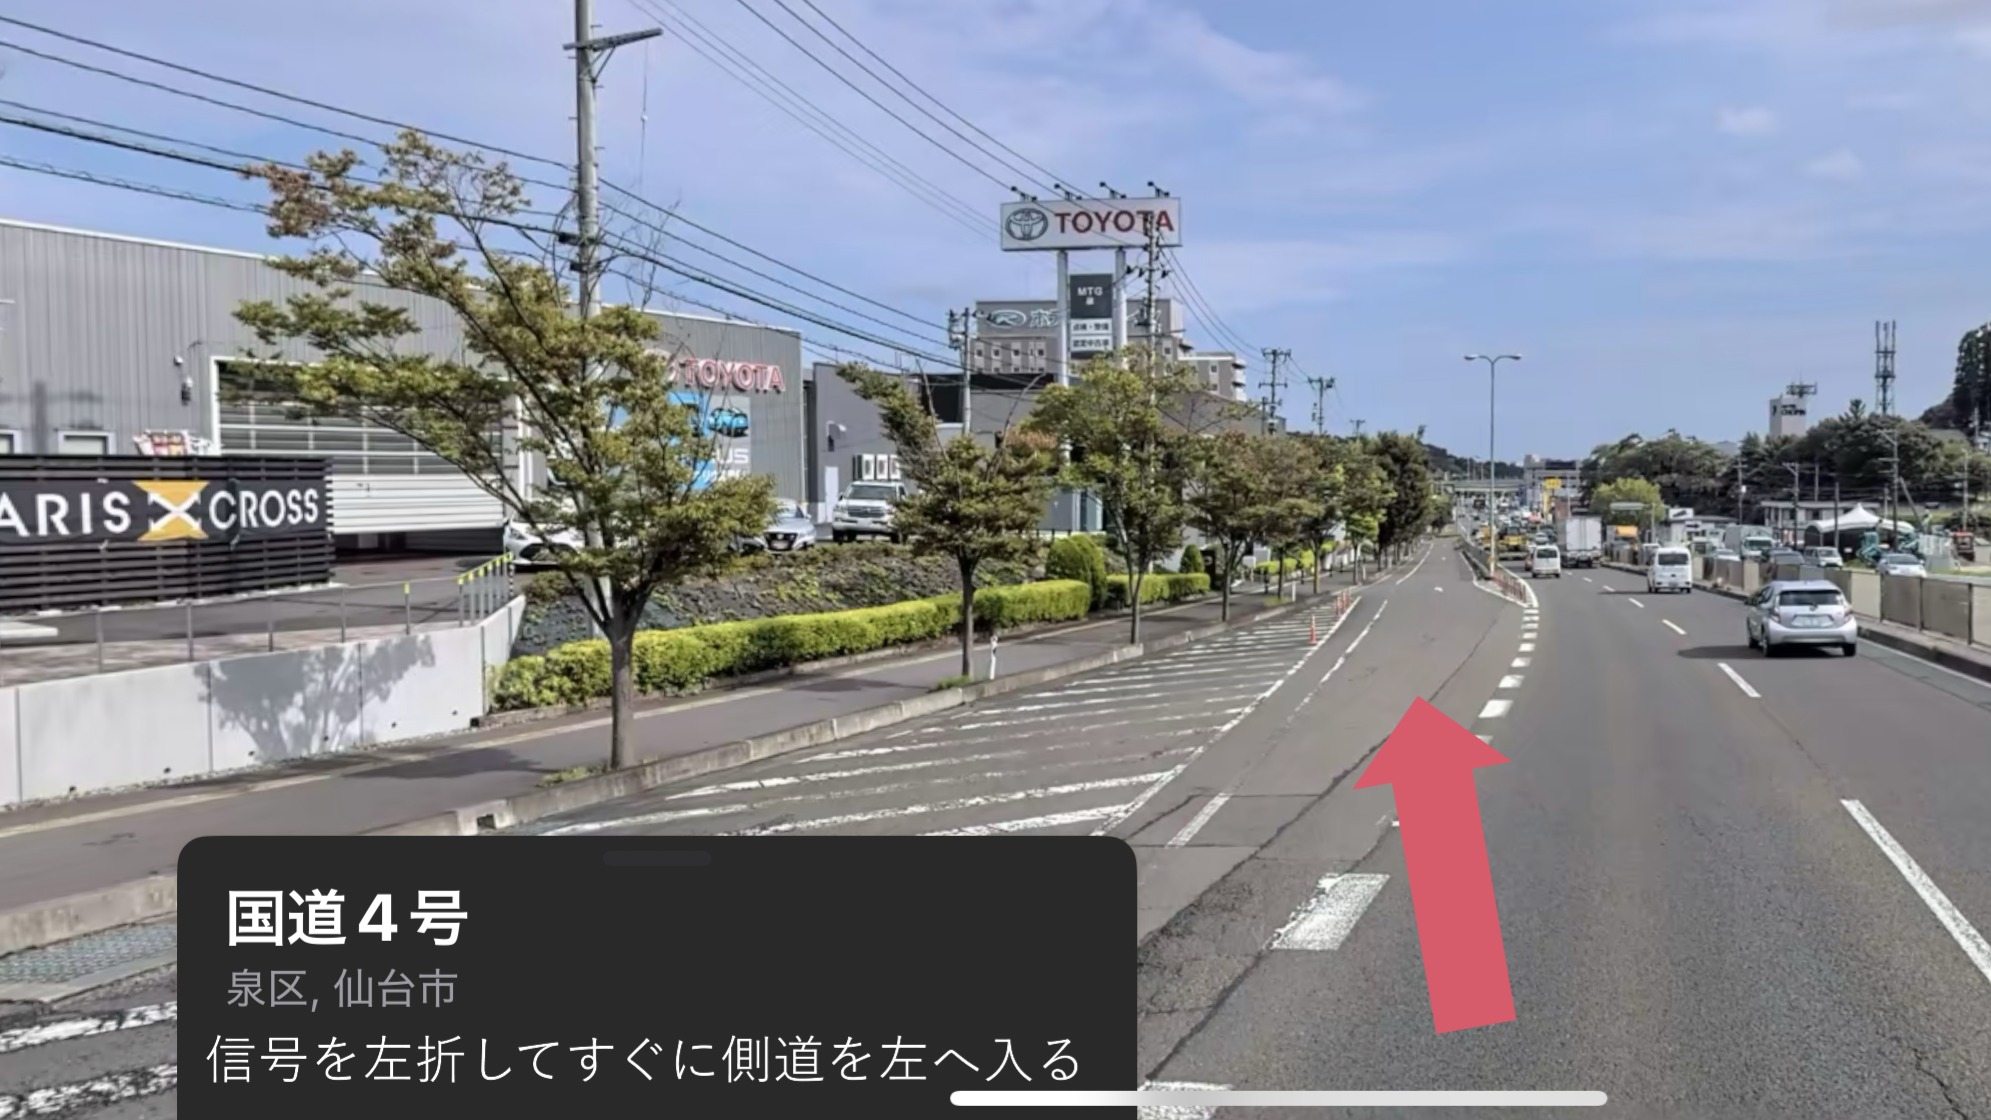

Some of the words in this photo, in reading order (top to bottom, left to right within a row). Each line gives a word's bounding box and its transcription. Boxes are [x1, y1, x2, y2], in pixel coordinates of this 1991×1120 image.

[1054, 210, 1174, 236] TOYOTA
[1077, 286, 1103, 296] MTG
[683, 358, 786, 393] TOYOTA
[0, 490, 131, 537] ARIS
[208, 488, 319, 531] CROSS
